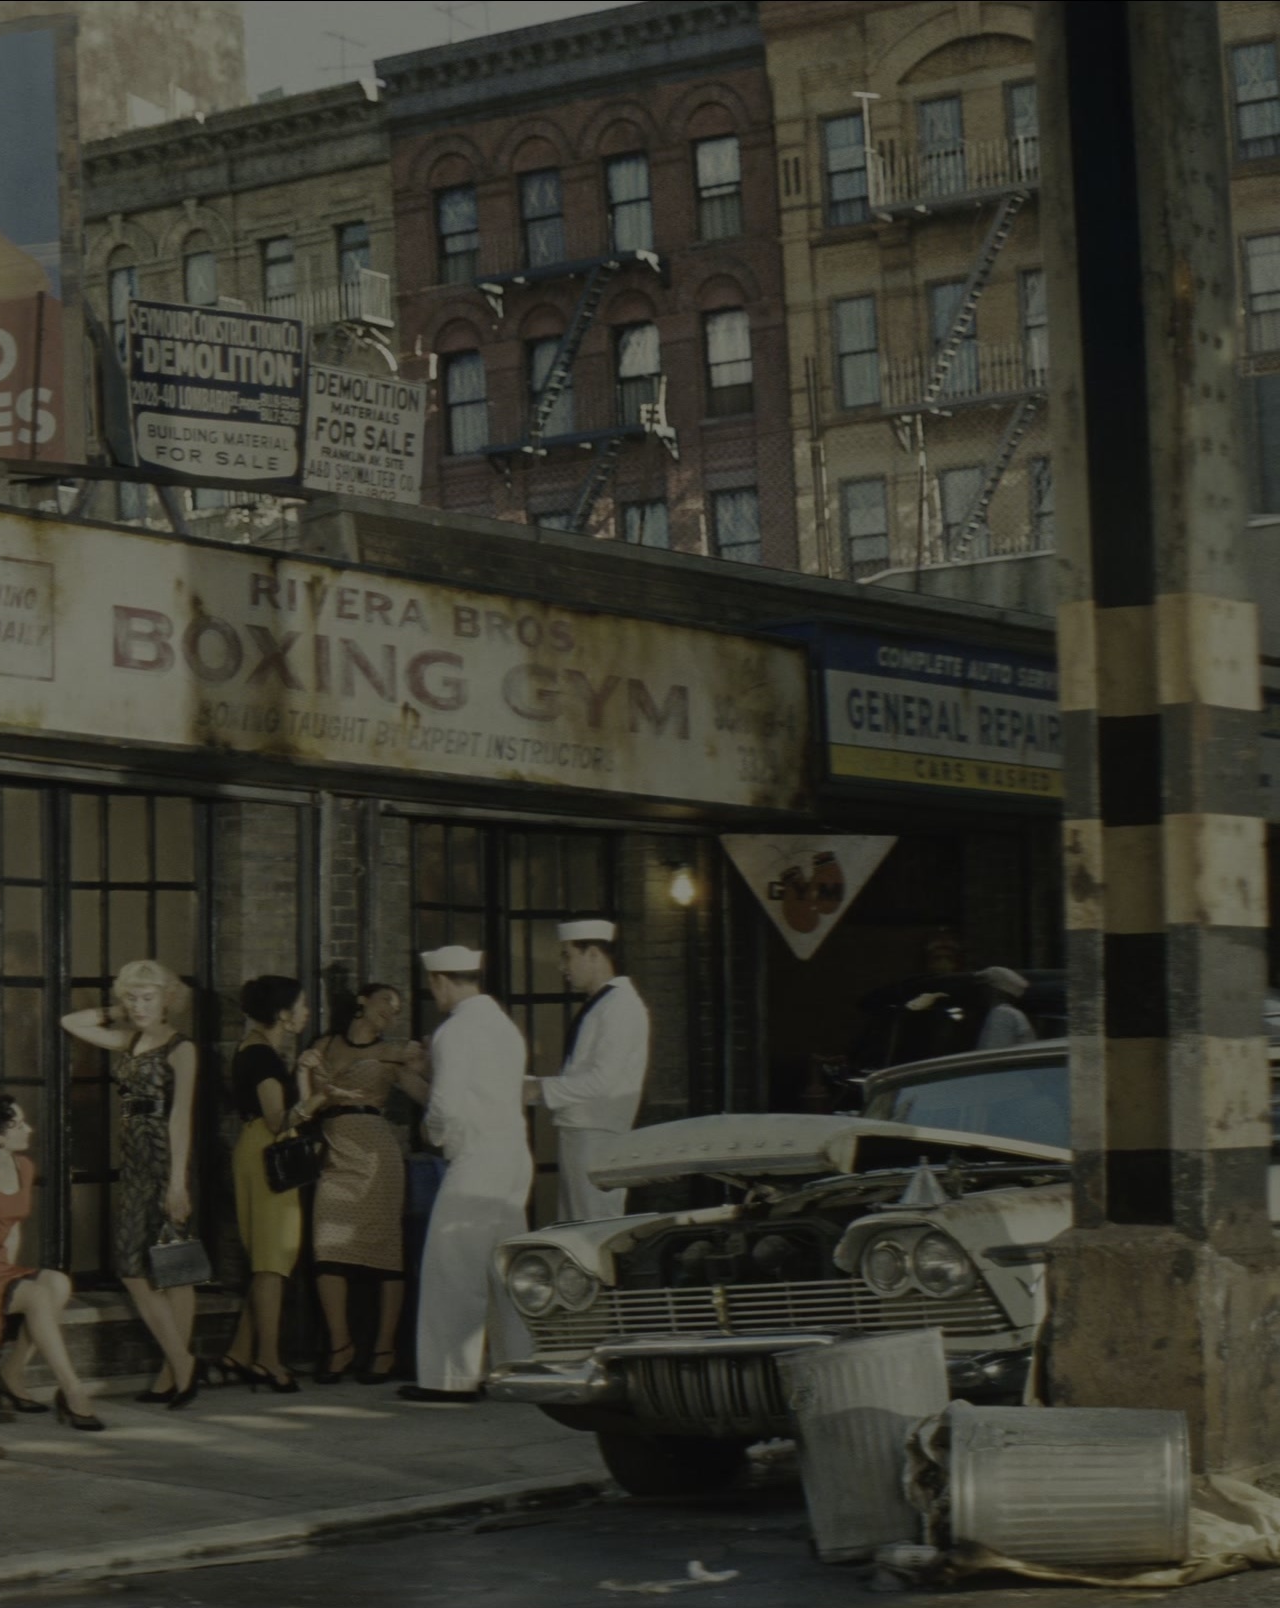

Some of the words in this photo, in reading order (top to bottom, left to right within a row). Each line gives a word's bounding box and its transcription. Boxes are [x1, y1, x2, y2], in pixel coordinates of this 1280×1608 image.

[191, 311, 281, 348] CONSTRUCTION
[143, 338, 295, 388] DEMOLITION
[315, 371, 420, 413] DEMOLITION
[330, 401, 400, 426] MATERIALS
[147, 423, 219, 445] BUILDING
[223, 430, 290, 451] MATERIAL
[314, 415, 357, 448] FOR
[363, 426, 416, 458] SALE
[320, 446, 366, 464] FRANKLIN
[155, 445, 202, 464] FOR
[215, 450, 280, 471] SALE
[247, 572, 429, 633] RIVERA
[112, 604, 470, 713] BOXING
[501, 662, 692, 742] GYM
[877, 645, 964, 679] COMPLETE
[966, 658, 1012, 685] AUTO
[288, 709, 367, 746] TAUGHT
[407, 724, 482, 757] EXPERT
[847, 687, 968, 744] GENERAL
[913, 757, 966, 782] CARS
[977, 765, 1051, 792] WASHED
